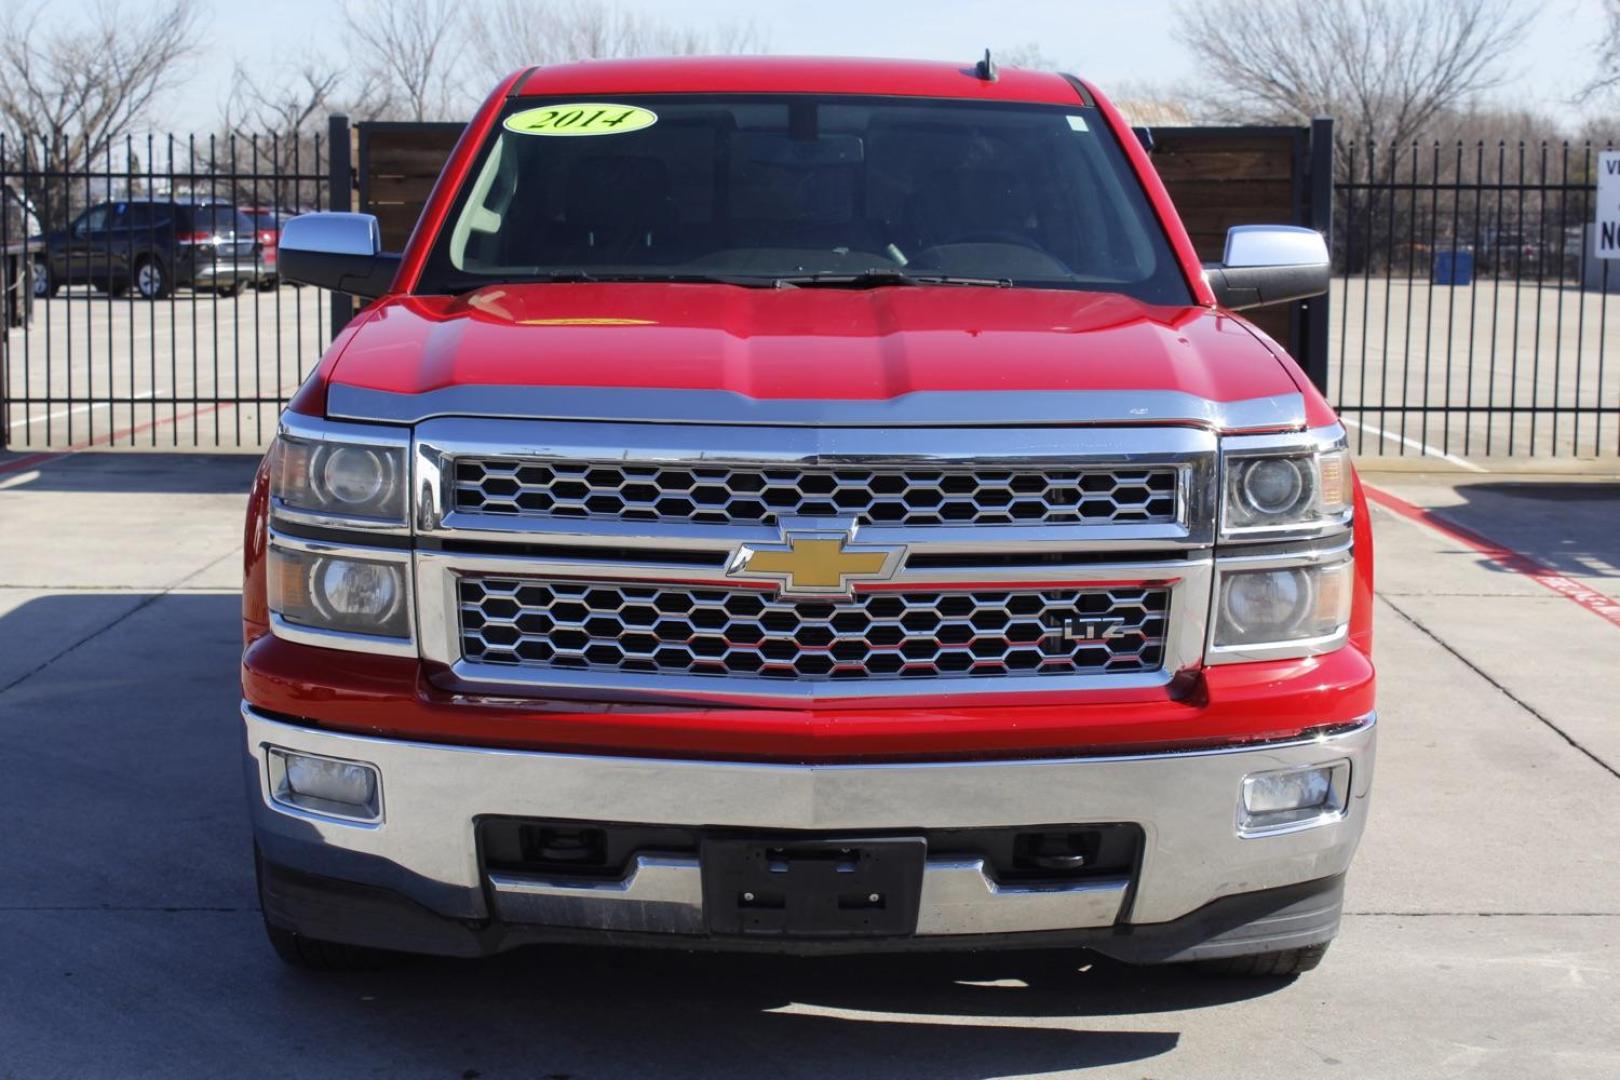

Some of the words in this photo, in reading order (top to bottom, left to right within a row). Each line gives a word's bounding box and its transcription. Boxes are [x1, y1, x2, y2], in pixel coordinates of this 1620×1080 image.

[525, 109, 634, 129] 2014
[1601, 221, 1620, 250] N
[1064, 617, 1125, 640] LTZ
